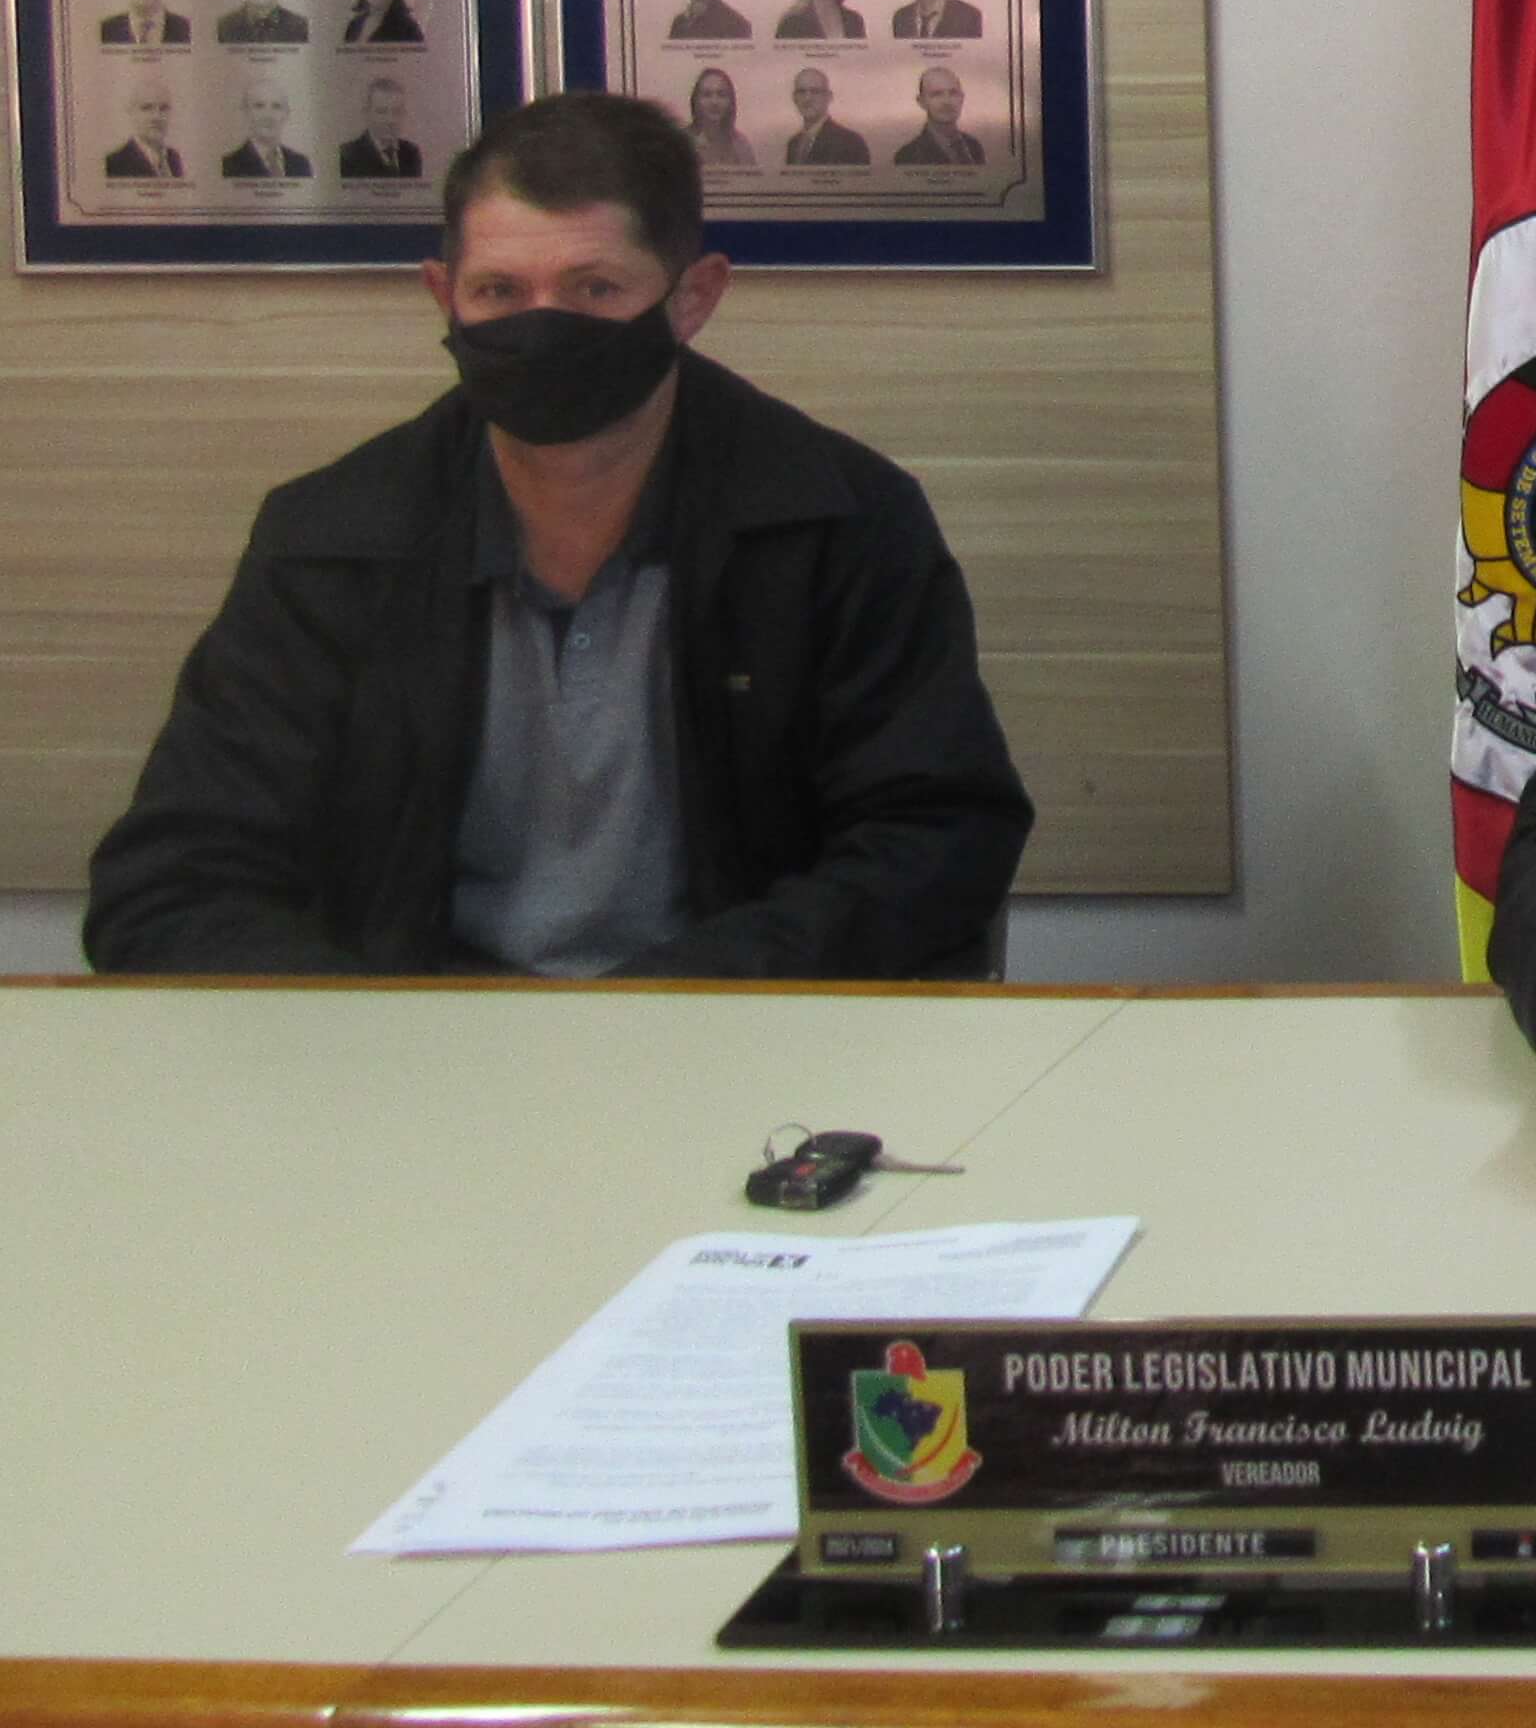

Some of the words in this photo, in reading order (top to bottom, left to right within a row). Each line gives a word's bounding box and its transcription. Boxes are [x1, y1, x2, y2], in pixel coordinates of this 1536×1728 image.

[1517, 464, 1536, 495] DE
[1005, 1354, 1115, 1393] PODER
[1123, 1351, 1337, 1392] LEGISLATIVO
[1346, 1349, 1533, 1390] MUNICIPAL
[1052, 1410, 1171, 1446] Milton
[1182, 1409, 1347, 1445] Francisco
[1360, 1409, 1484, 1453] Ludvig
[1222, 1462, 1320, 1486] VEREADOR
[1101, 1534, 1266, 1556] PRESIDENTE
